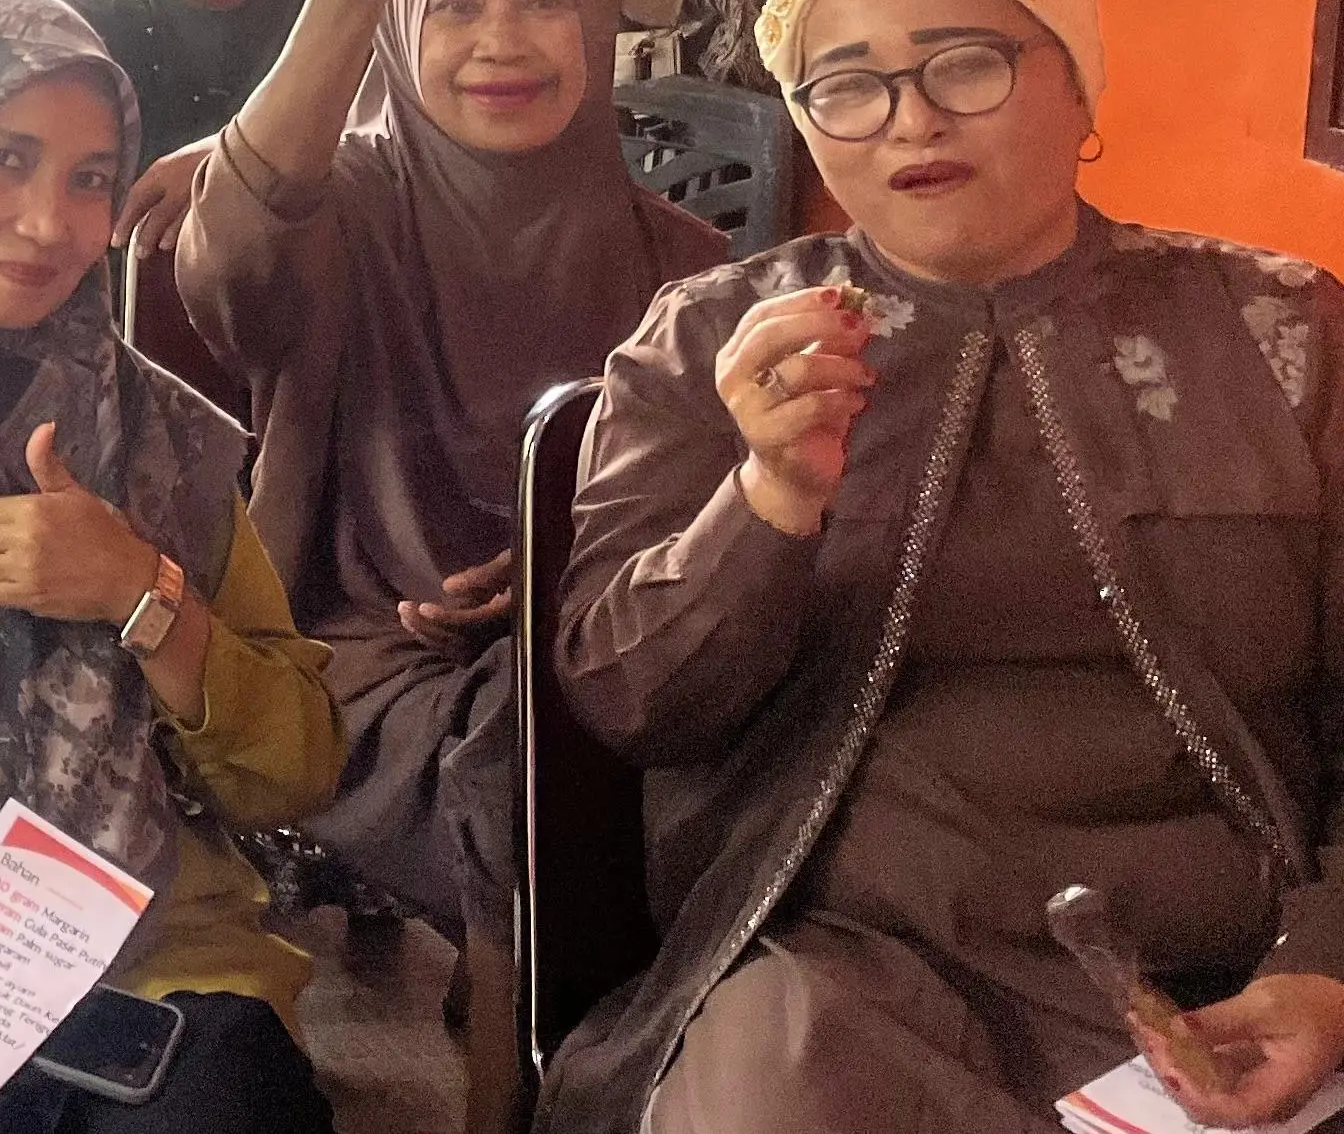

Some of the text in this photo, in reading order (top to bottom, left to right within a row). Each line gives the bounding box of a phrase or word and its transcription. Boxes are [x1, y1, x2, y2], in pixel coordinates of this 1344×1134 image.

[0, 852, 40, 886] Bahan
[9, 889, 40, 913] gram
[41, 906, 91, 943] Margarin
[15, 932, 43, 955] Palm
[49, 932, 77, 954] Pasir
